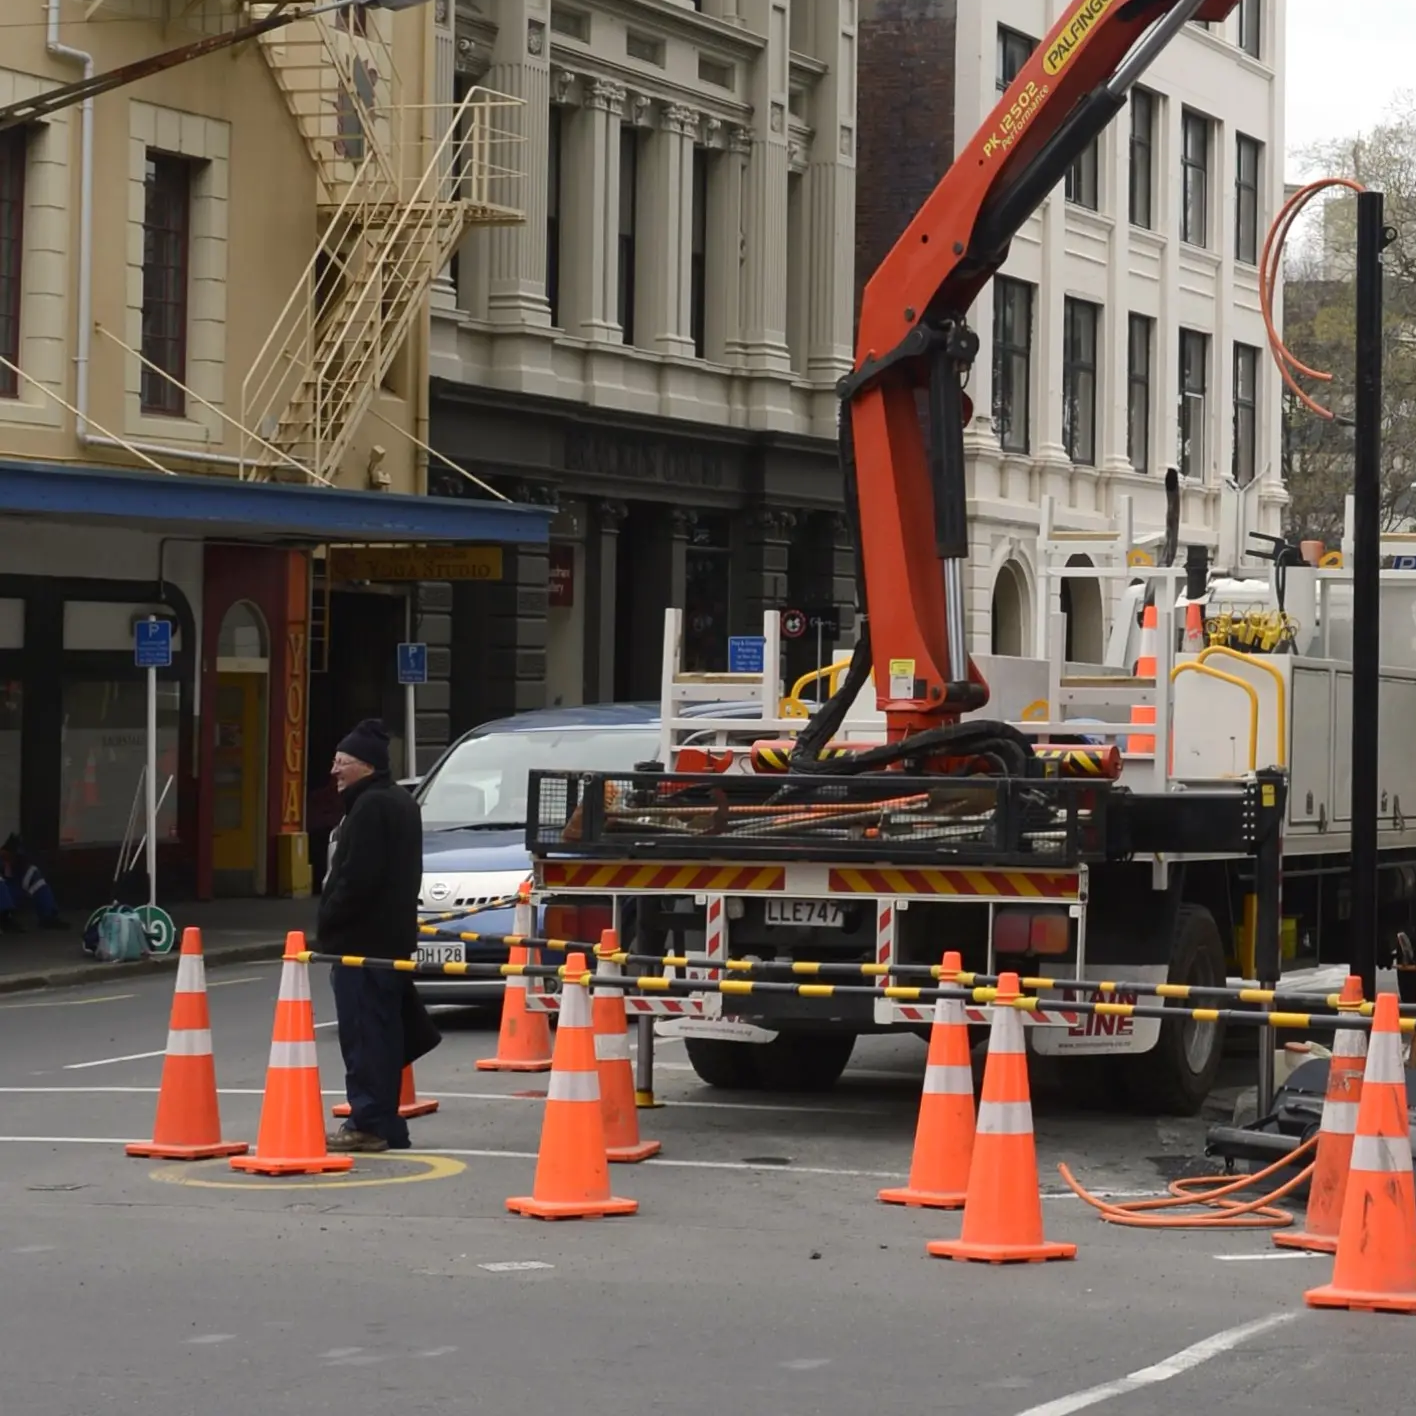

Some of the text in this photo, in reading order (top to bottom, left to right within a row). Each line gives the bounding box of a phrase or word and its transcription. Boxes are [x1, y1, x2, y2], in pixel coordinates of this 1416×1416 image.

[983, 81, 1038, 158] PK 12502
[1000, 85, 1049, 151] Performance
[423, 559, 491, 579] STUDIO
[148, 624, 160, 637] P
[409, 646, 417, 658] P
[284, 633, 304, 824] YOGA
[768, 900, 839, 923] LLE747
[416, 948, 463, 963] DH128
